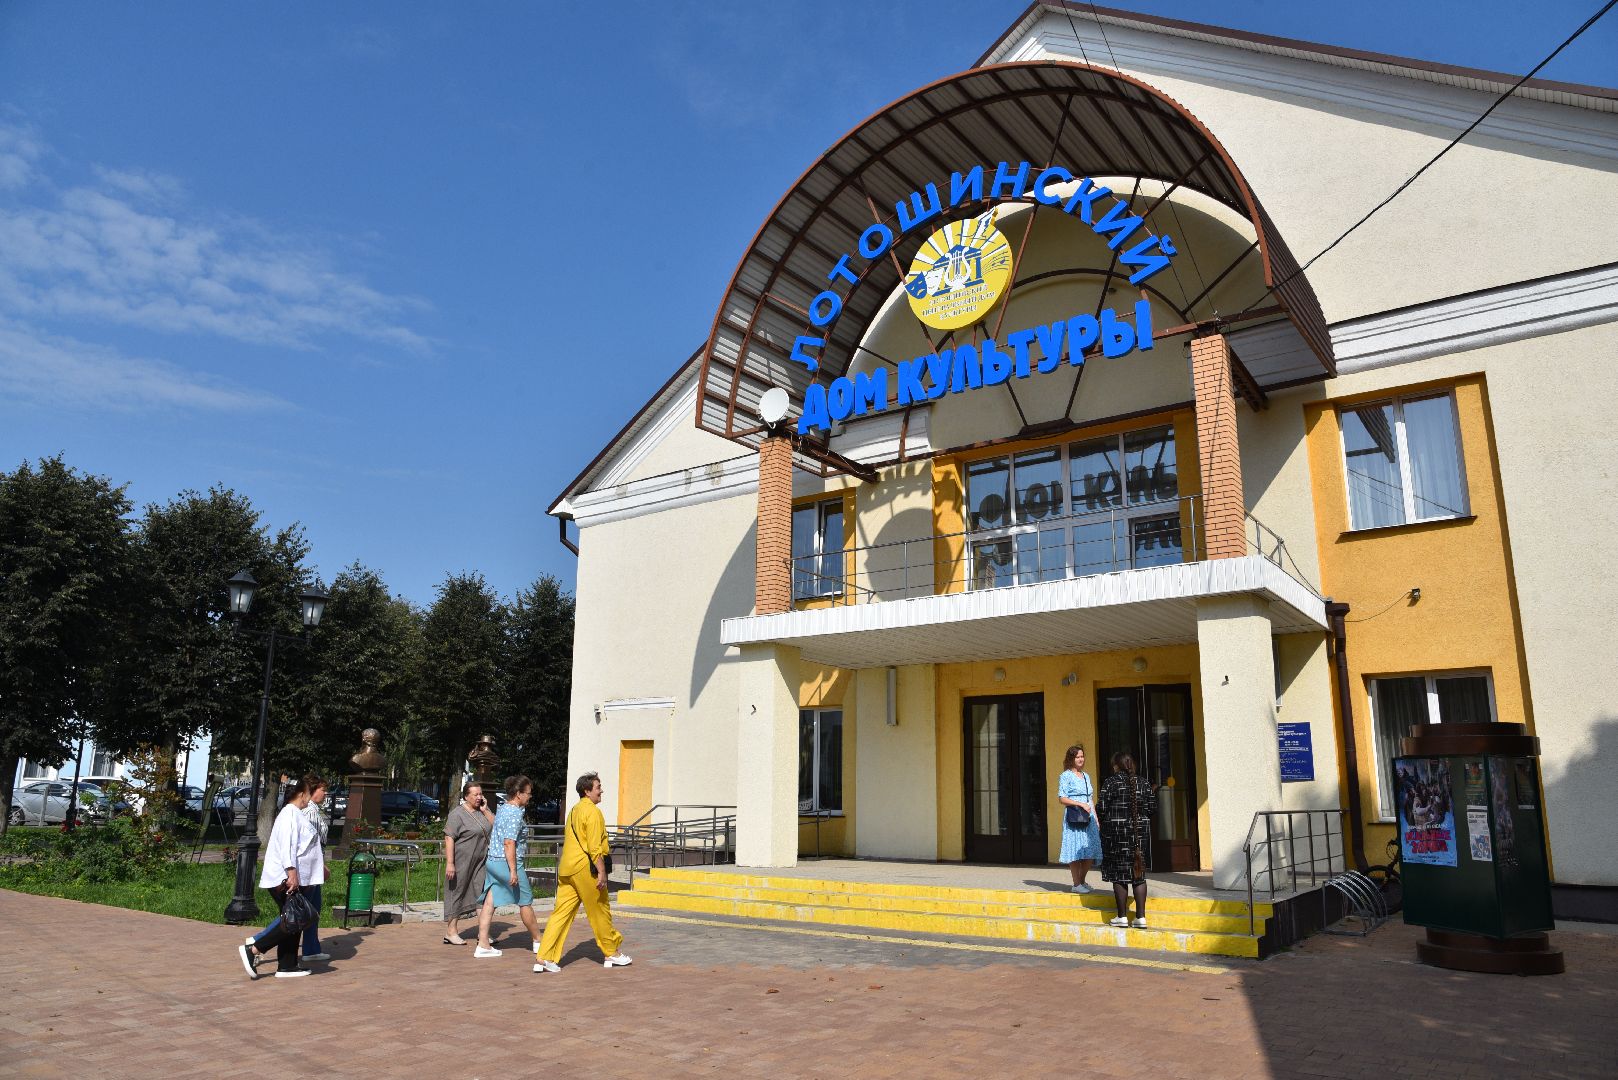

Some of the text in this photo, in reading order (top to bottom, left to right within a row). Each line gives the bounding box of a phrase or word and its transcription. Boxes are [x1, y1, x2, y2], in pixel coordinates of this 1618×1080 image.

[789, 160, 1179, 373] ЛОТОШИНСКИЙ
[797, 300, 1154, 435] ДОМ КУЛЬТУРЫ
